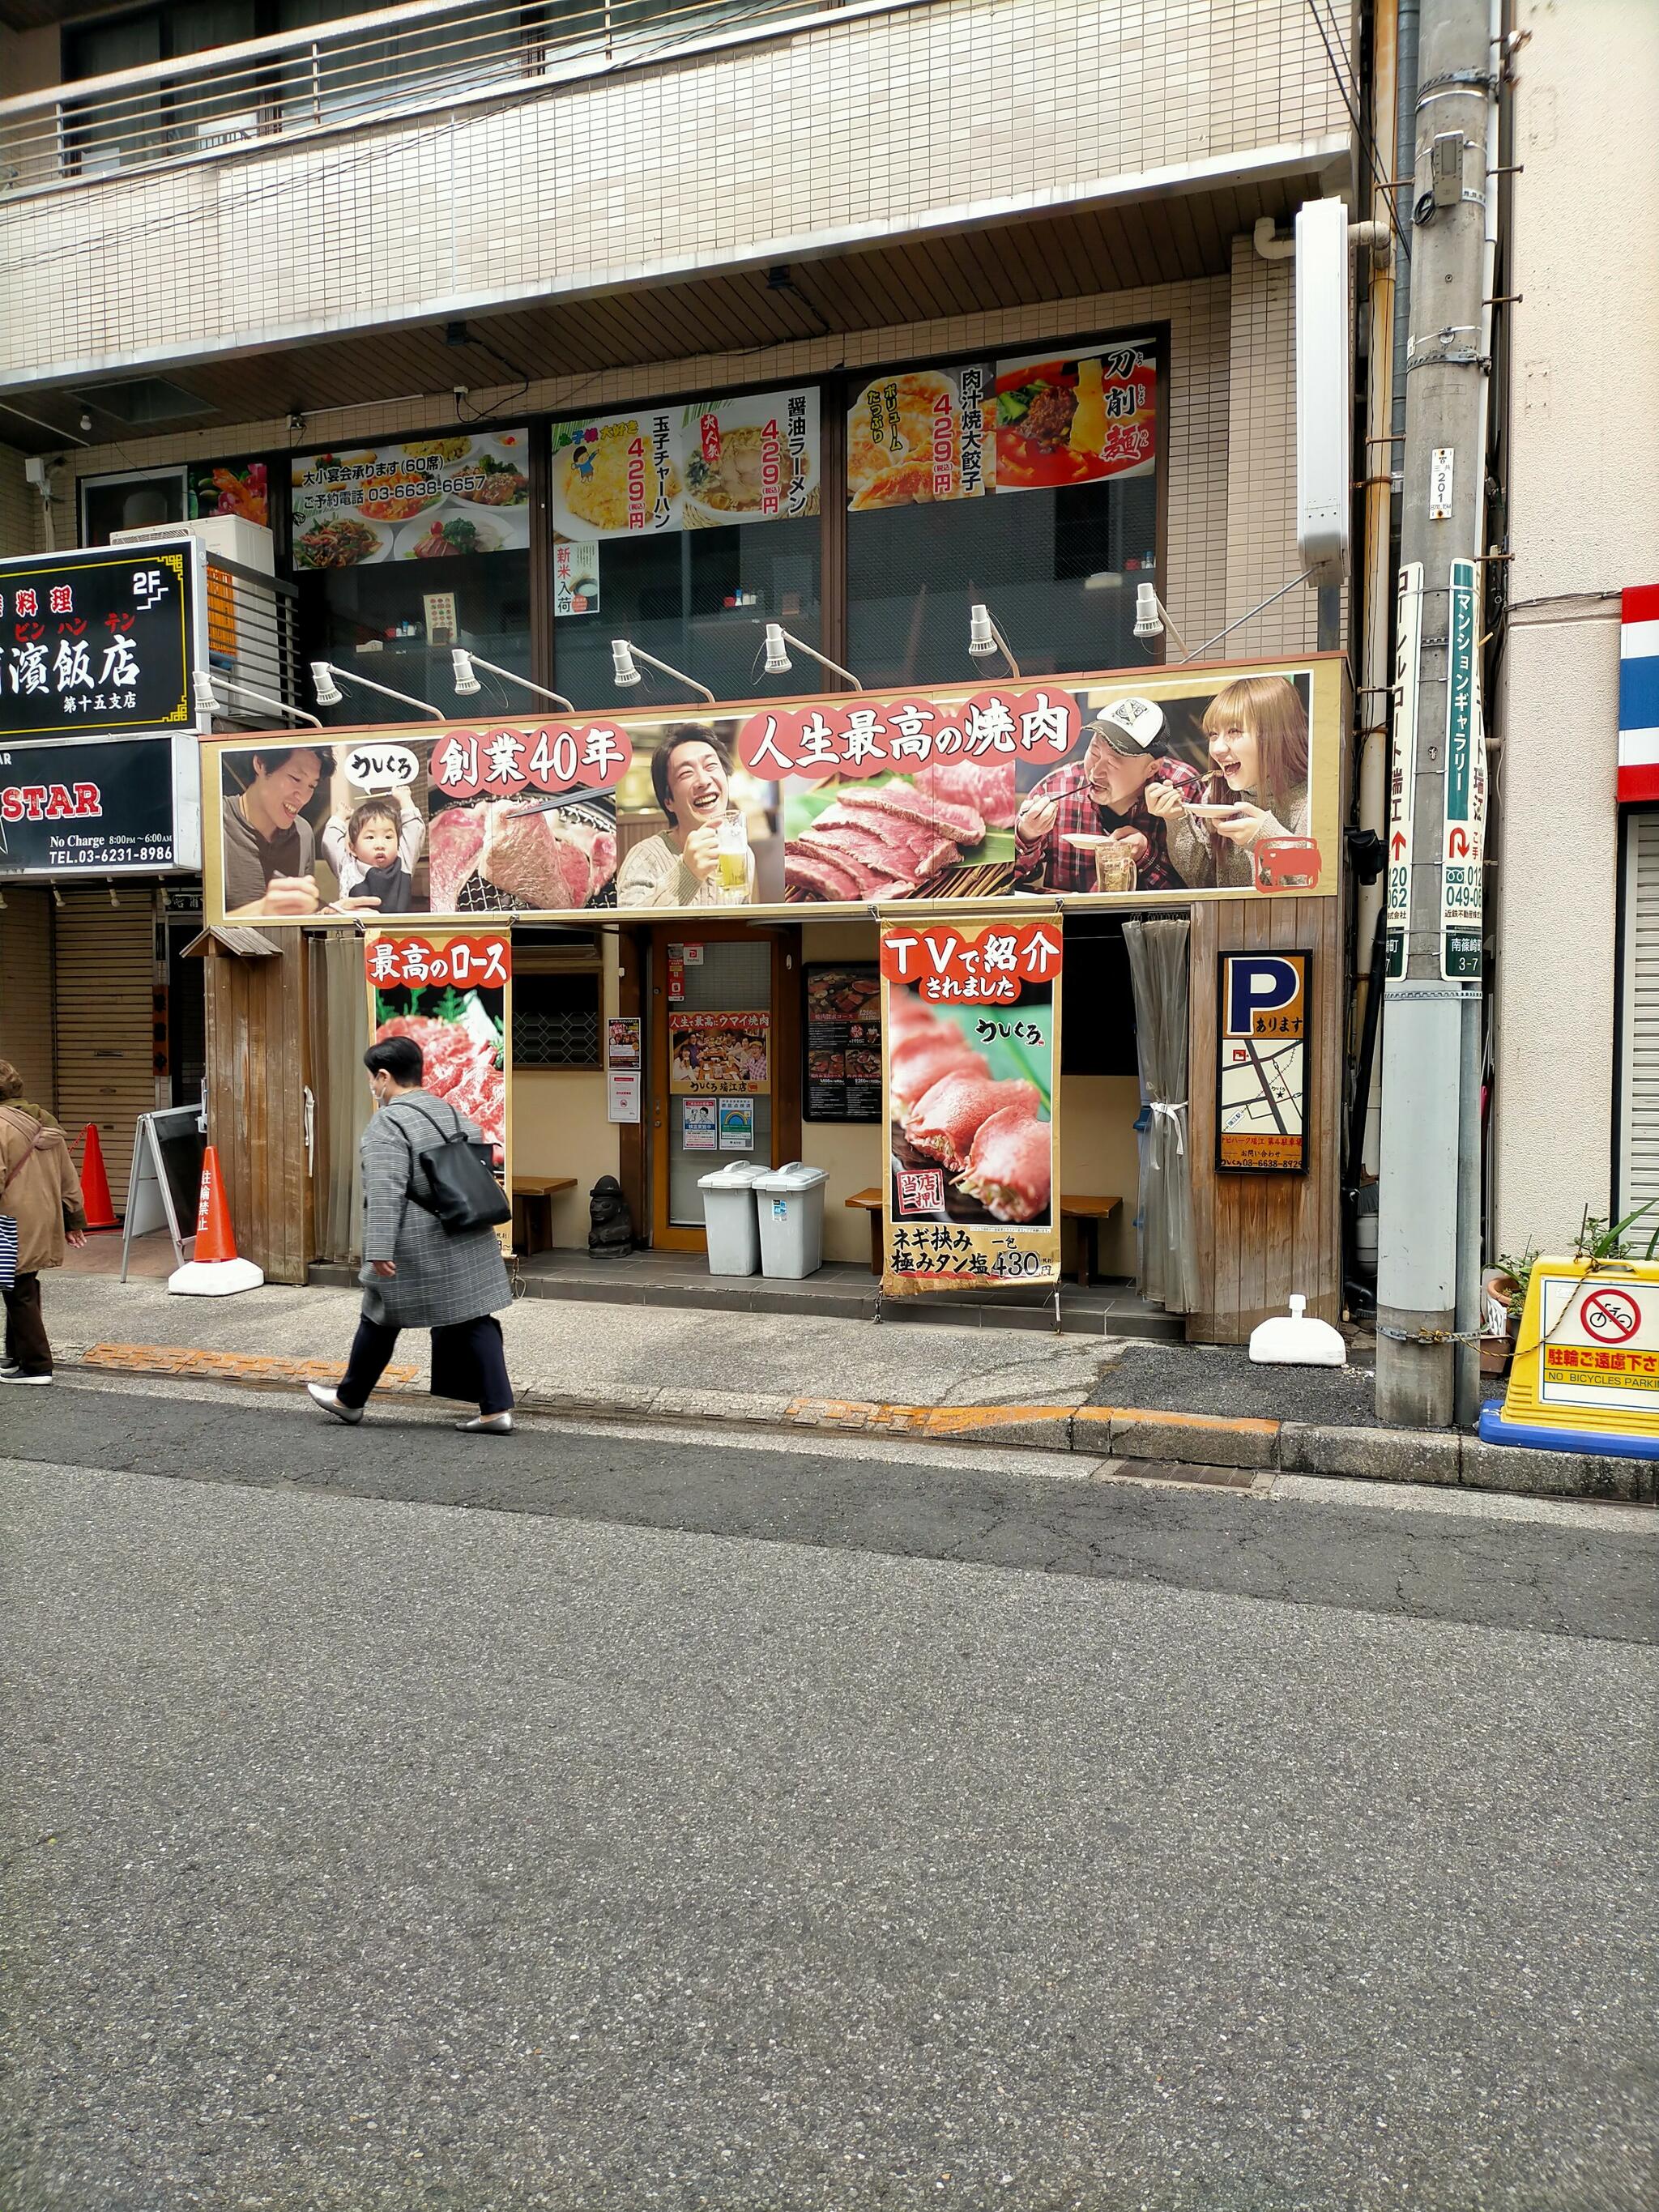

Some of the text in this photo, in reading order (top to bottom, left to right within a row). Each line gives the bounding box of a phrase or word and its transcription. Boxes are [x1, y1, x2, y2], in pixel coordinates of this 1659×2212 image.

[868, 390, 884, 443] たっぷり
[884, 384, 902, 452] ボリューム
[962, 369, 982, 492] 肉汁焼大餃子
[653, 416, 670, 529] 玉子チャーハン
[304, 475, 486, 509] ご予約電話 03-6638-6657
[133, 570, 160, 595] 2F
[557, 546, 572, 613] 新米入荷
[0, 584, 73, 618] 料理
[0, 634, 141, 695] 濱飯店
[63, 691, 137, 714] 第十五支店
[1454, 594, 1471, 791] マンションギャラリー
[748, 693, 1069, 769] 人生最高の焼肉
[352, 754, 412, 779] うしくろ
[439, 729, 625, 786] 創業40年
[49, 846, 173, 864] TEL.03-6231-8986
[50, 836, 65, 847] No
[67, 834, 104, 848] Charge
[368, 943, 507, 982] 最高のロース
[885, 930, 1060, 974] TVで紹介
[1459, 957, 1478, 971] 3-7
[926, 975, 1015, 999] されました
[1227, 957, 1300, 1035] P
[975, 1018, 1042, 1046] うしくろ
[1256, 1016, 1303, 1033] あります
[893, 1226, 1017, 1251] ネギ挟み 一包
[891, 1250, 990, 1276] 極みタン塩
[992, 1251, 1039, 1277] 430
[1548, 1372, 1563, 1380] NO
[1570, 1373, 1622, 1386] BICYCLES
